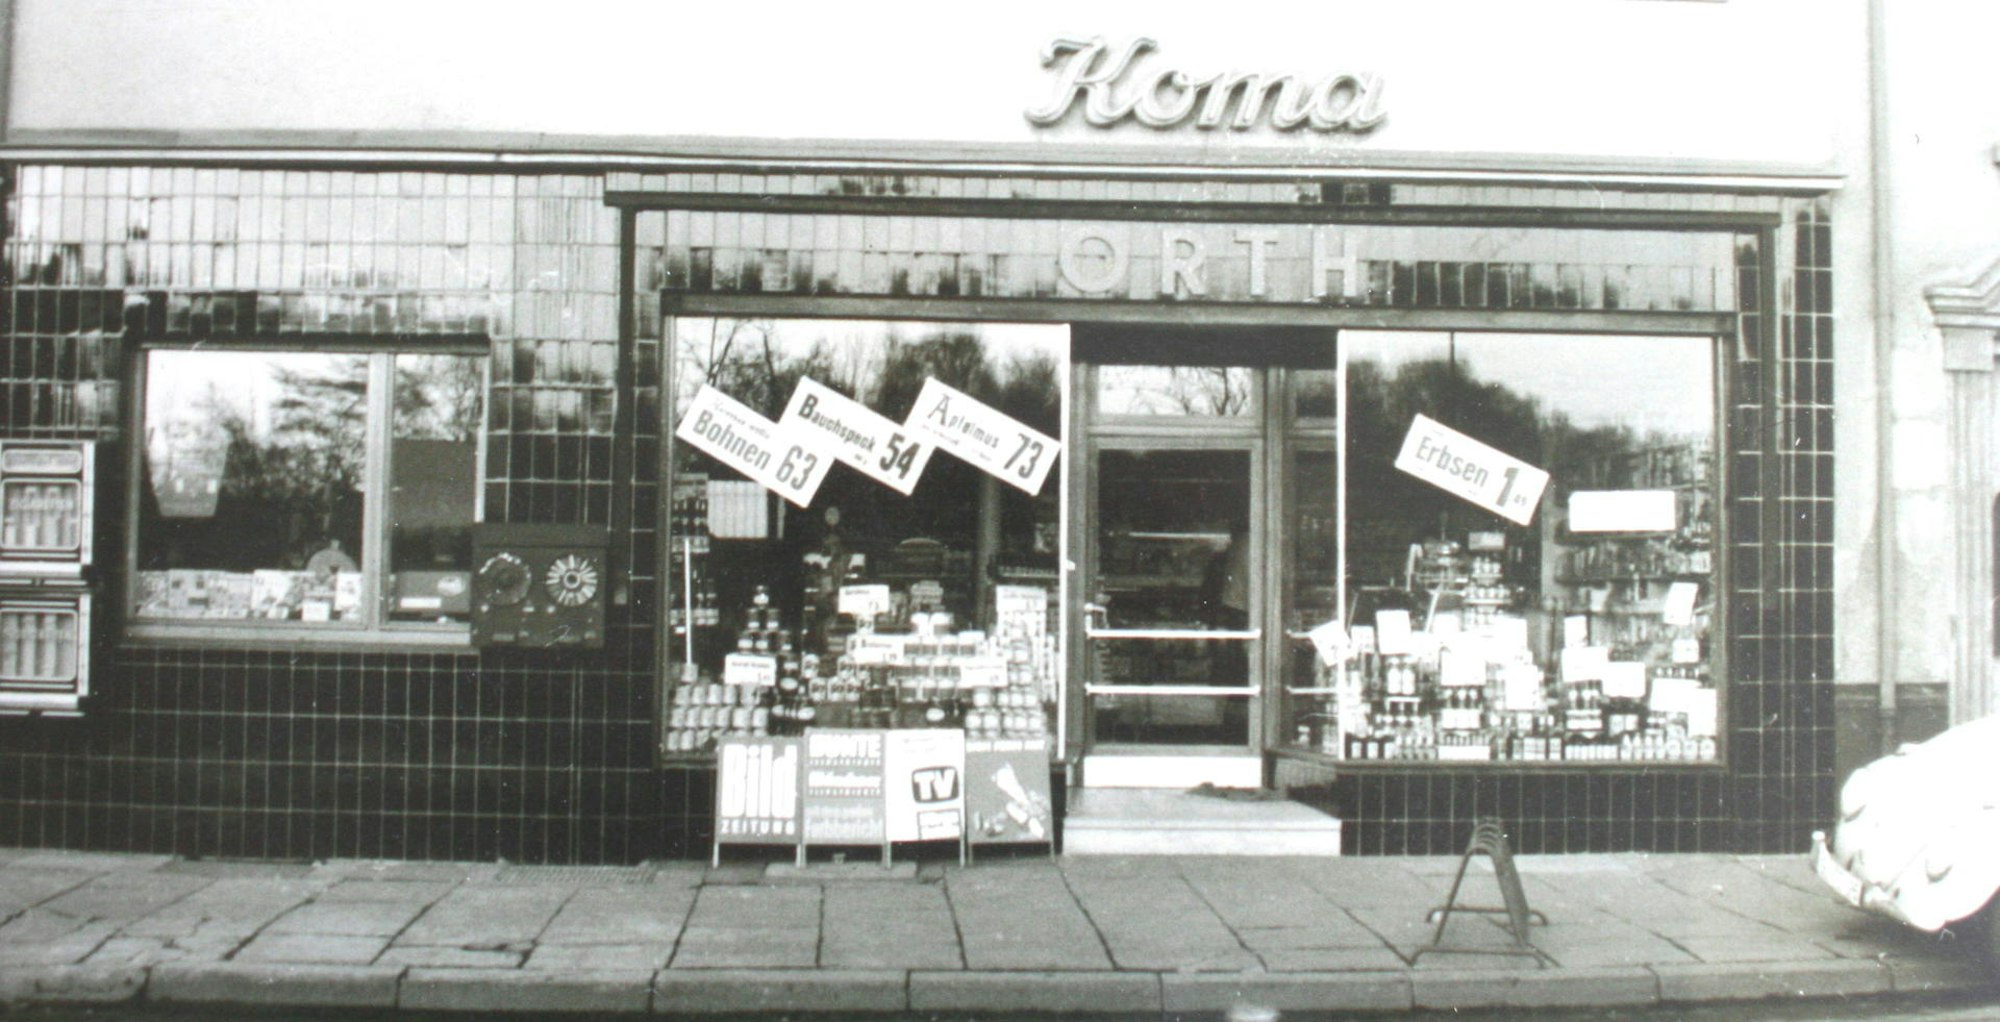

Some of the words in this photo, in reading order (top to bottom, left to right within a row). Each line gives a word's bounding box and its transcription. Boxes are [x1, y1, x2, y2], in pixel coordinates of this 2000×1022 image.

[1023, 35, 1389, 134] Koma
[1058, 226, 1359, 297] ORTH
[692, 408, 772, 471] Bohnen
[775, 444, 819, 492] 63
[797, 393, 876, 453] Bauchspeck
[879, 431, 921, 481] 54
[1003, 432, 1045, 480] 73
[1415, 435, 1490, 488] Erbsen
[721, 744, 798, 818] Bild
[914, 768, 956, 800] TV
[720, 819, 796, 835] ZEITUNG
